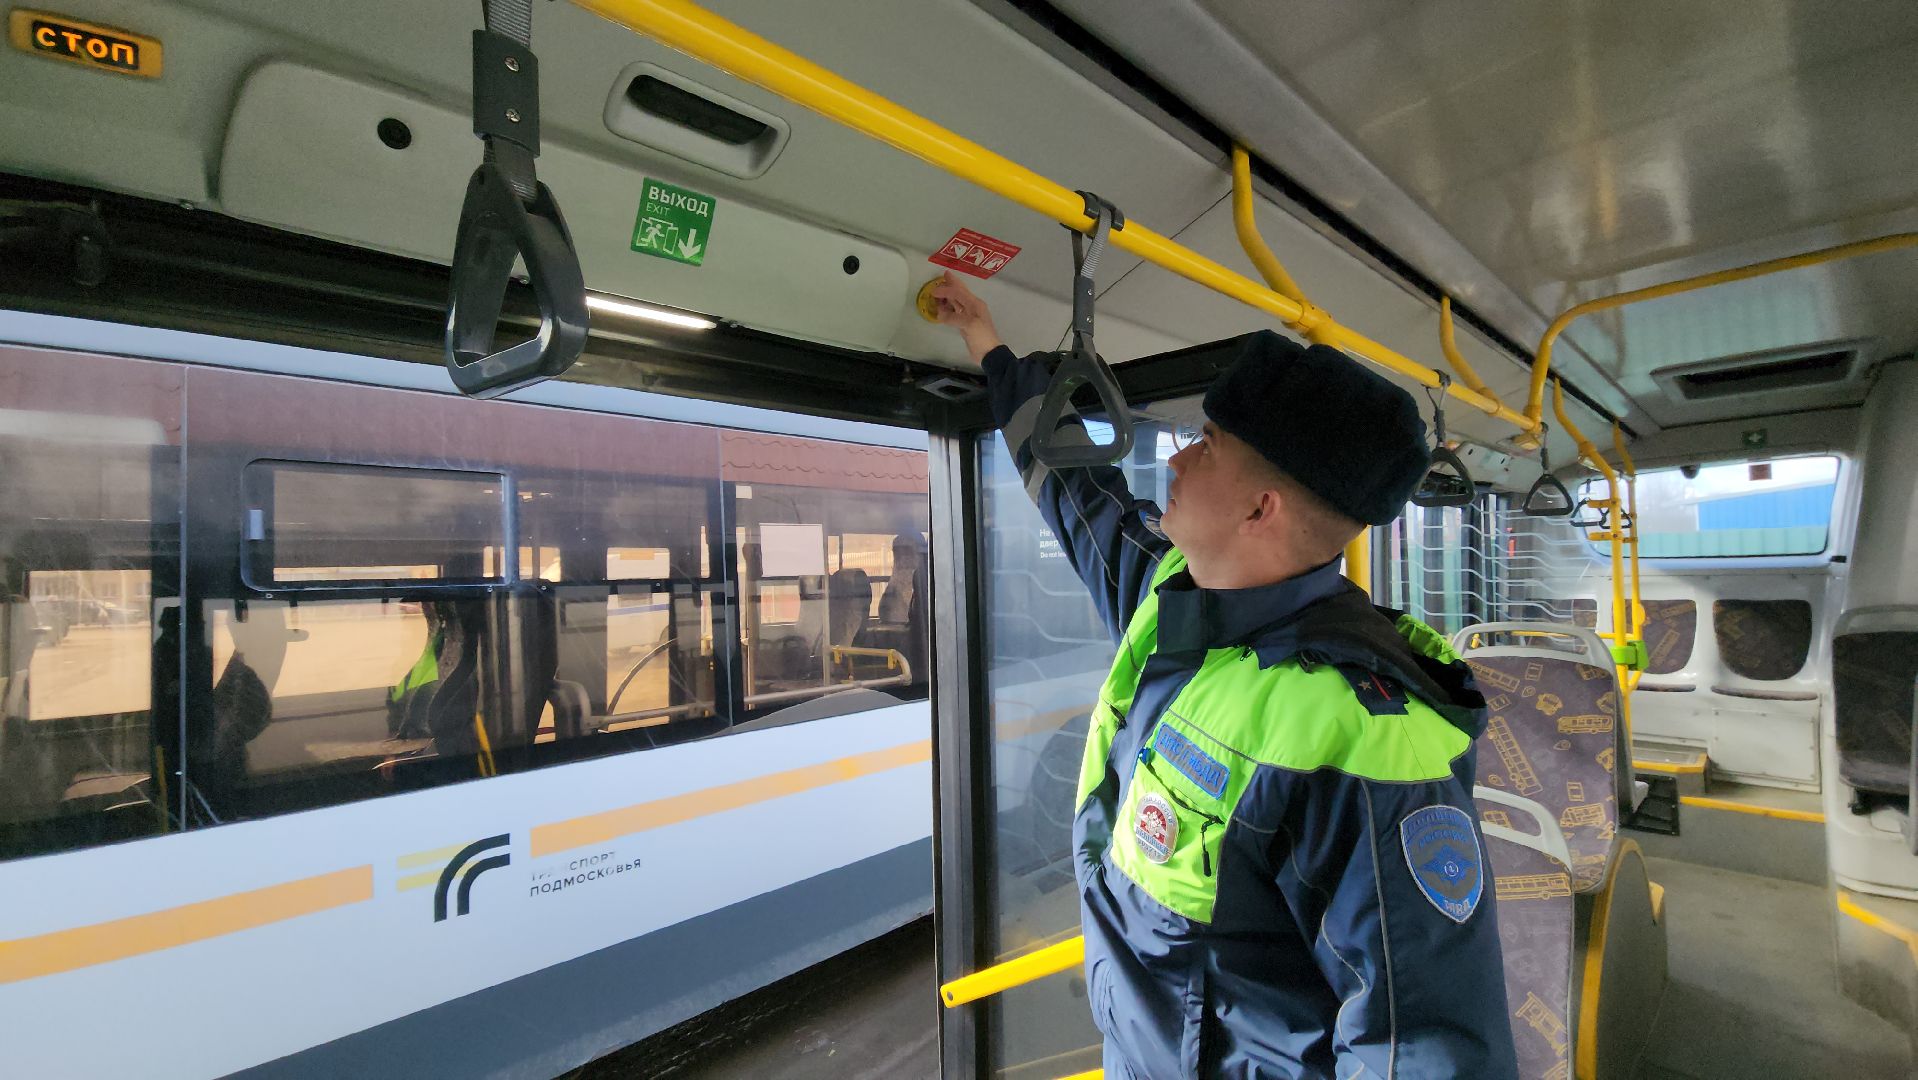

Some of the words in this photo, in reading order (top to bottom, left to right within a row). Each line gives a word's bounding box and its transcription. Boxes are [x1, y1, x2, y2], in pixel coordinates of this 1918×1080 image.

[36, 27, 134, 65] СТОП
[645, 201, 671, 216] EXIT
[648, 185, 709, 218] ВЫХОД
[1039, 540, 1059, 549] двер
[529, 858, 641, 897] ПОДМОСКОВЬЯ
